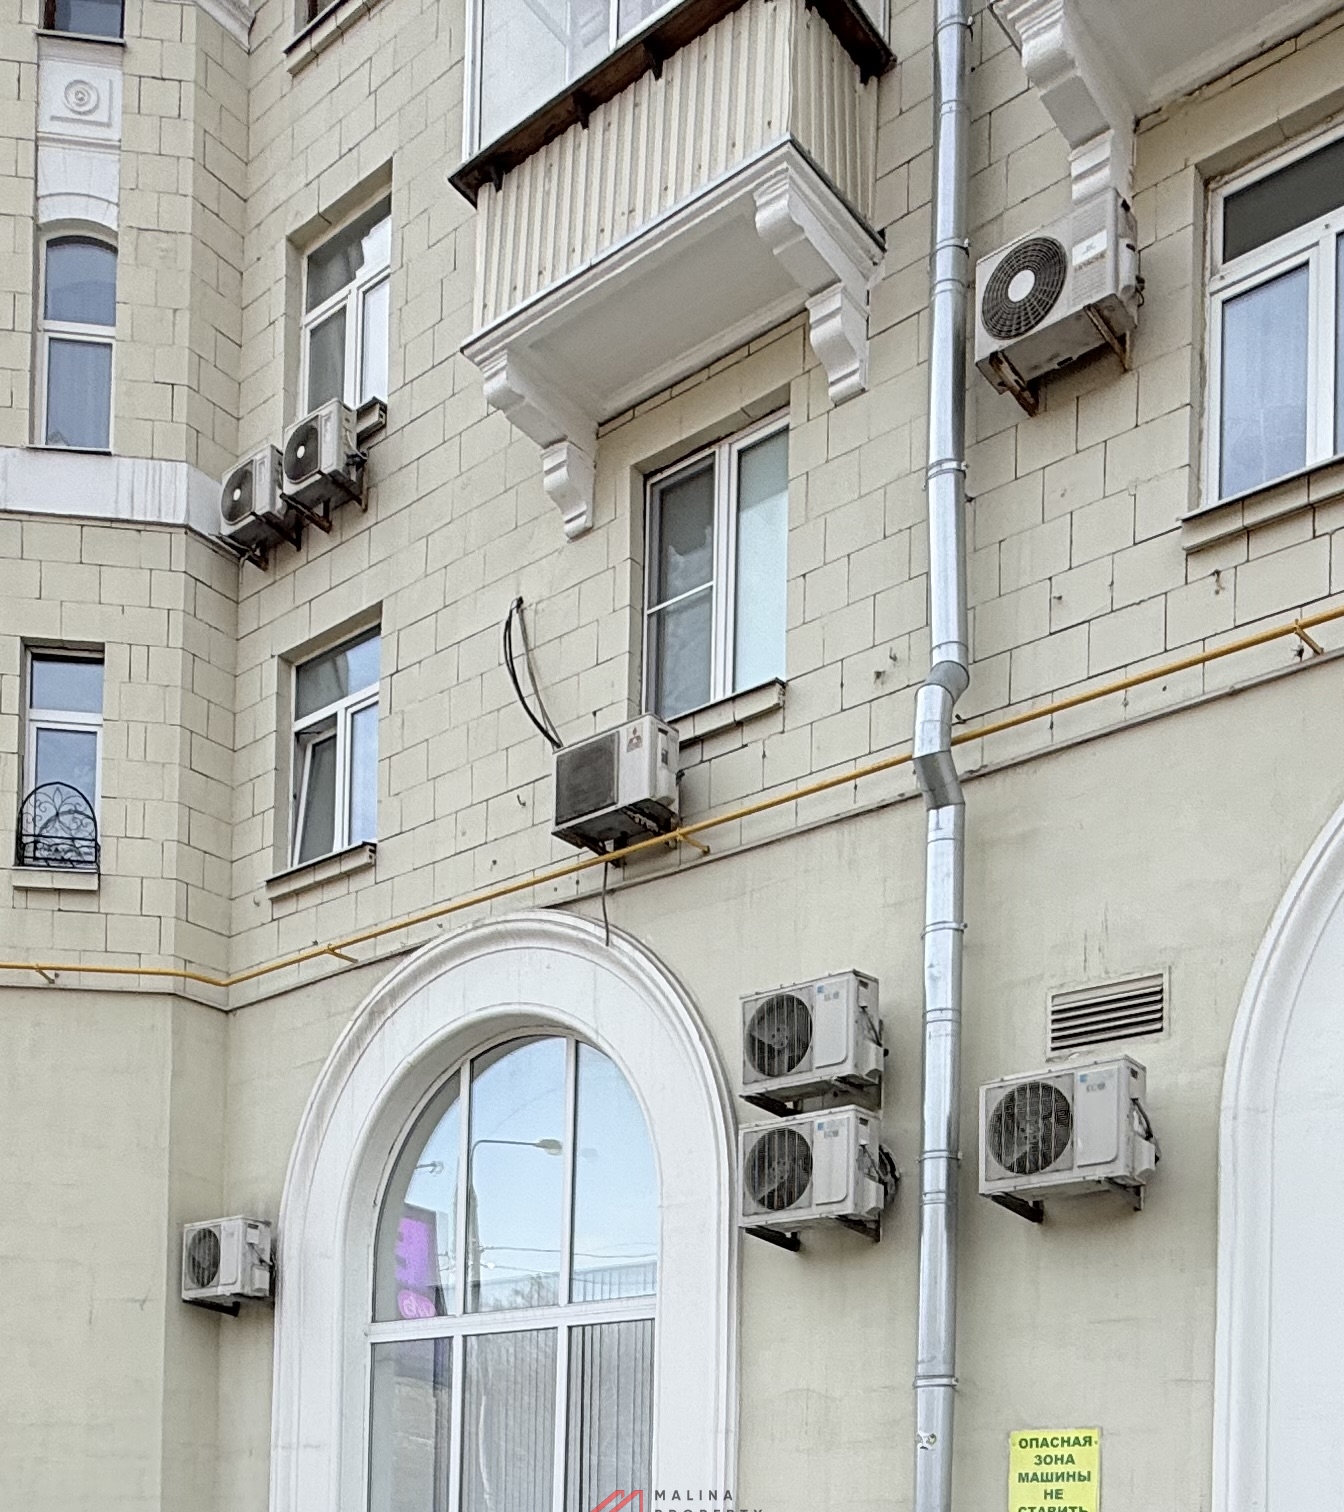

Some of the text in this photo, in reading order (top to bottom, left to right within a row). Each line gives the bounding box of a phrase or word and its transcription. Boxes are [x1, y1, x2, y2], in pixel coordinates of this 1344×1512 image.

[1018, 1435, 1092, 1449] ОПАСНАЯ
[1033, 1453, 1076, 1466] ЗОНА
[1017, 1470, 1091, 1483] МАШИНЫ
[1043, 1488, 1064, 1500] НЕ
